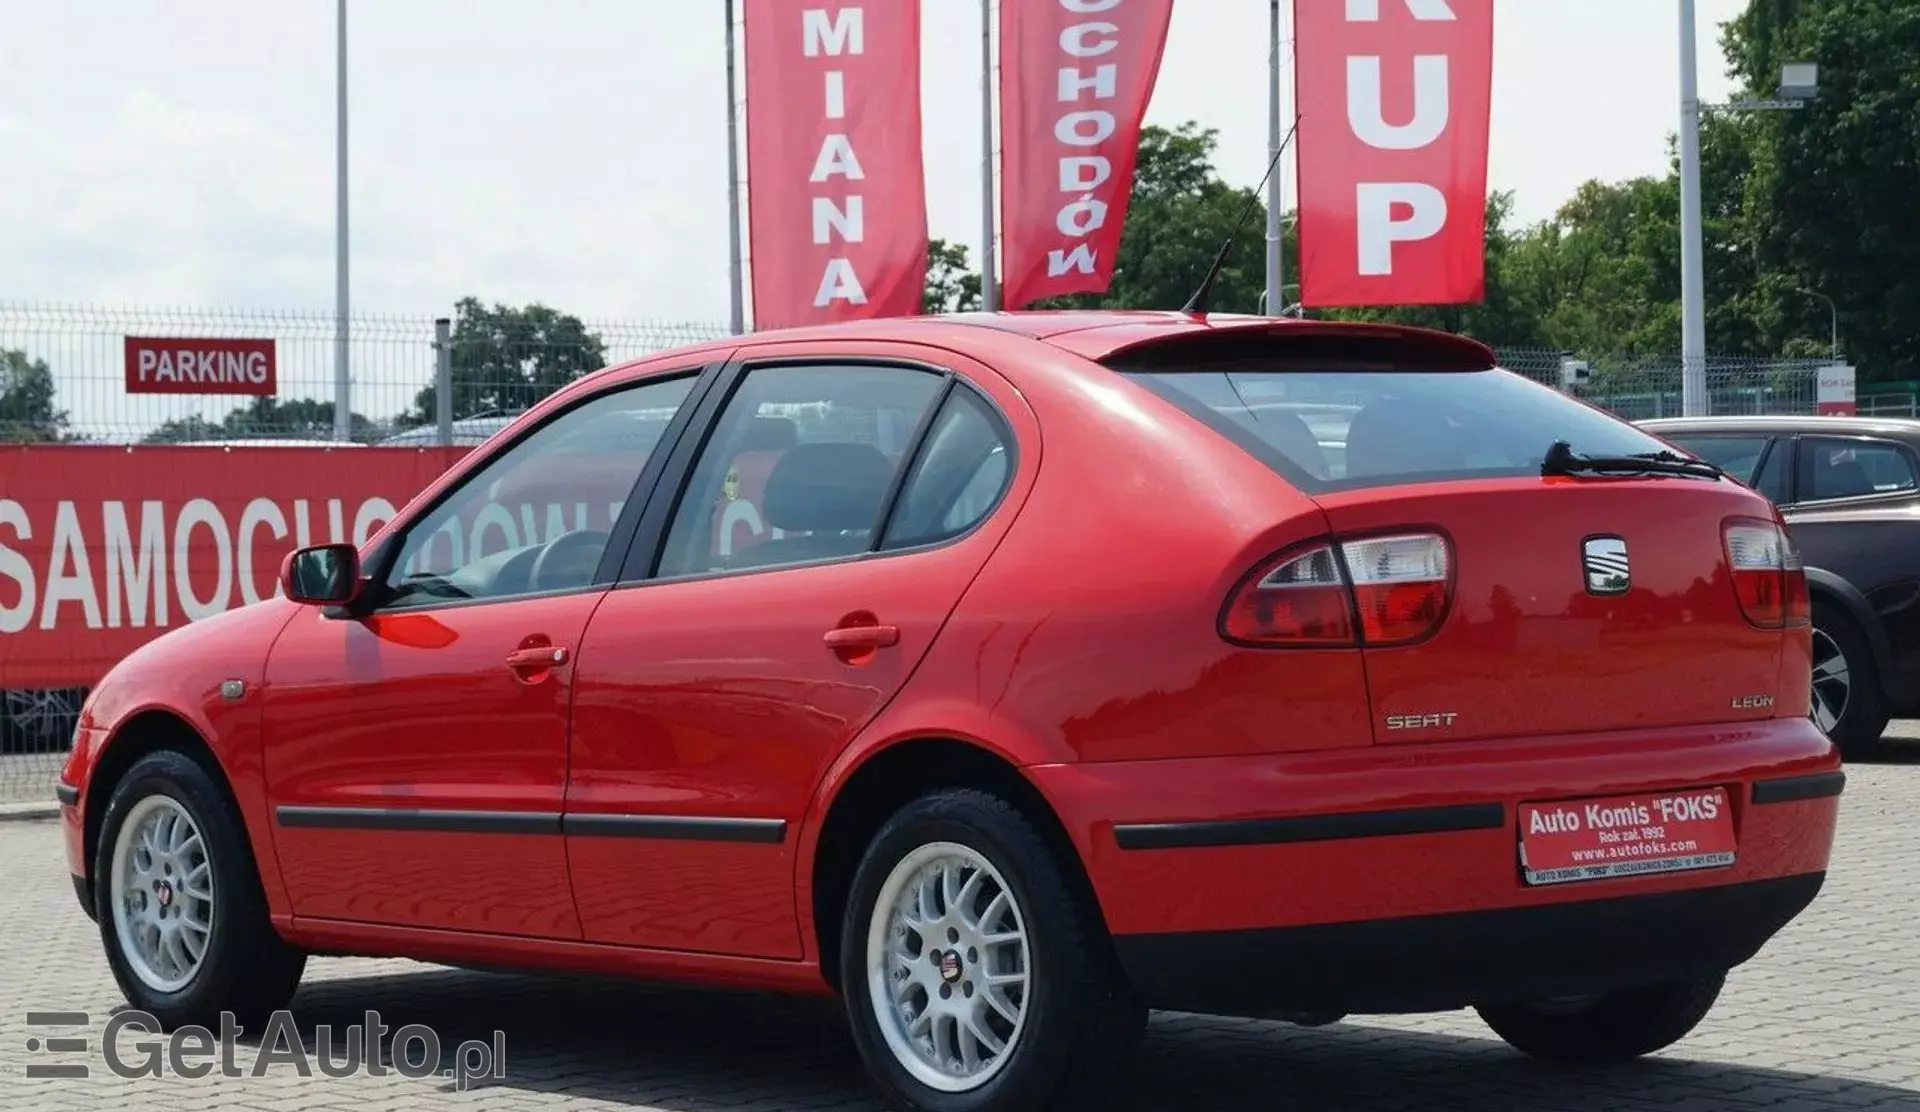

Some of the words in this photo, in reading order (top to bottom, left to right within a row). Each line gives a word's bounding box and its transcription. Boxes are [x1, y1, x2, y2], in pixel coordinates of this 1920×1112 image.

[1344, 0, 1457, 276] UP
[802, 7, 868, 308] MIANA
[137, 348, 268, 385] PARKING
[1386, 712, 1458, 730] SEAT
[1529, 809, 1579, 833] Auto
[1585, 802, 1650, 828] Komis
[1653, 794, 1722, 823] "FOKS"
[1571, 839, 1697, 861] www.autofoks.com
[1598, 829, 1621, 843] Rok
[1640, 826, 1666, 840] 1992
